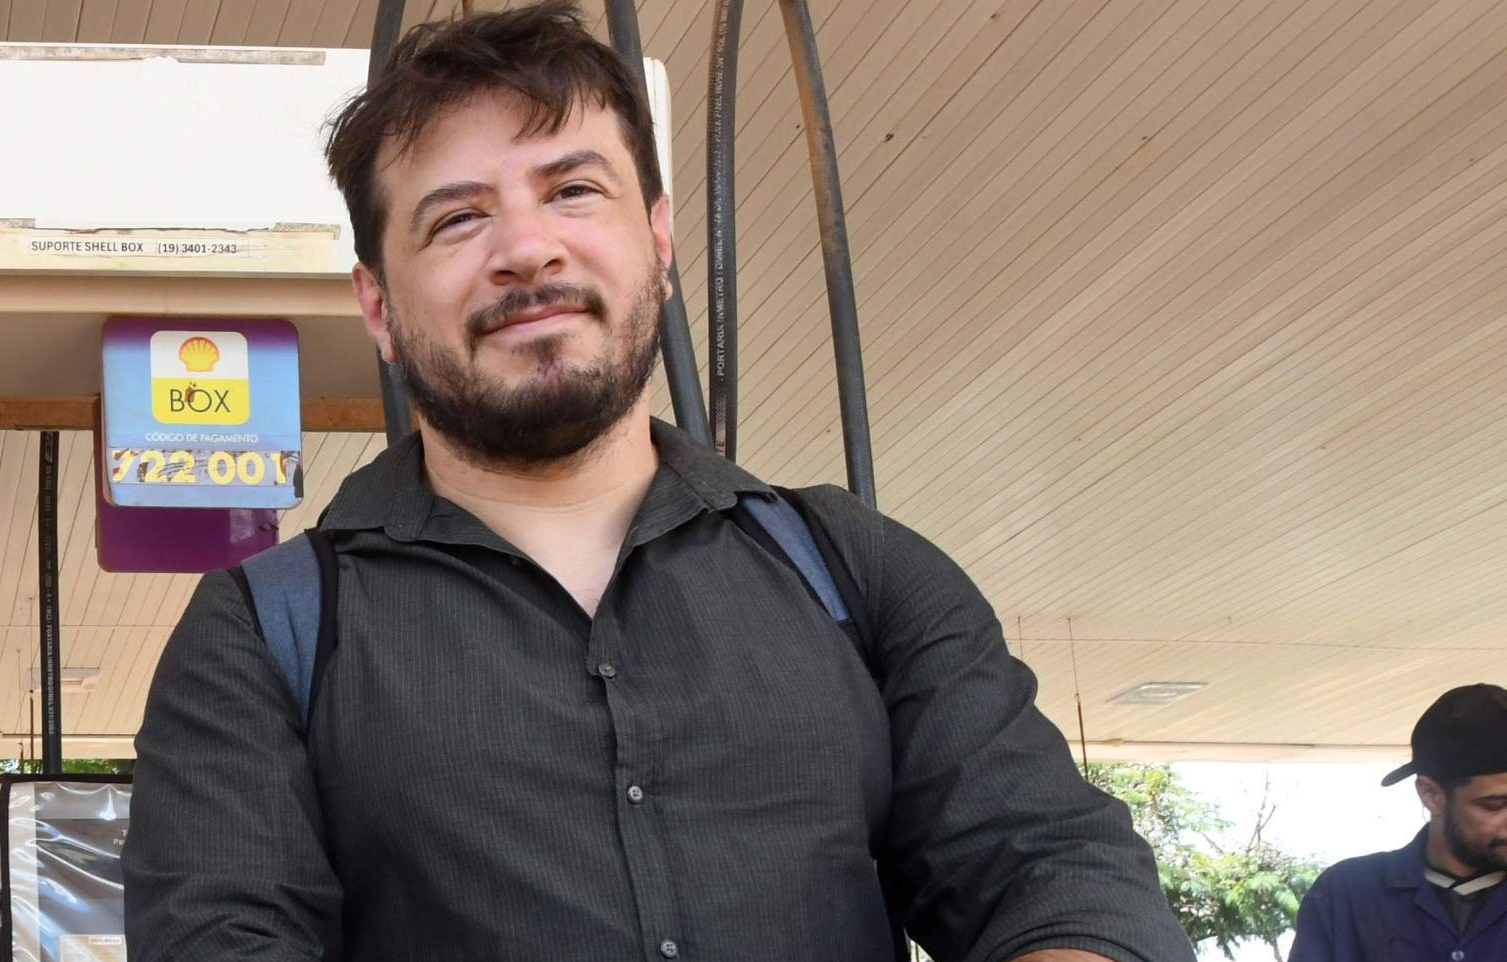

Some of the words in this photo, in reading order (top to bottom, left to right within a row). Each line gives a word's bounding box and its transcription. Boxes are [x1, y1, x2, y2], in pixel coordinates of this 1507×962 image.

[31, 241, 81, 252] SUPORTE
[85, 241, 118, 252] SHELL
[121, 242, 143, 253] BOX
[157, 243, 179, 254] (19)
[181, 243, 237, 254] 3401-2343
[169, 388, 231, 413] BOX
[186, 433, 197, 443] DE
[200, 433, 259, 444] PAGAMENTO
